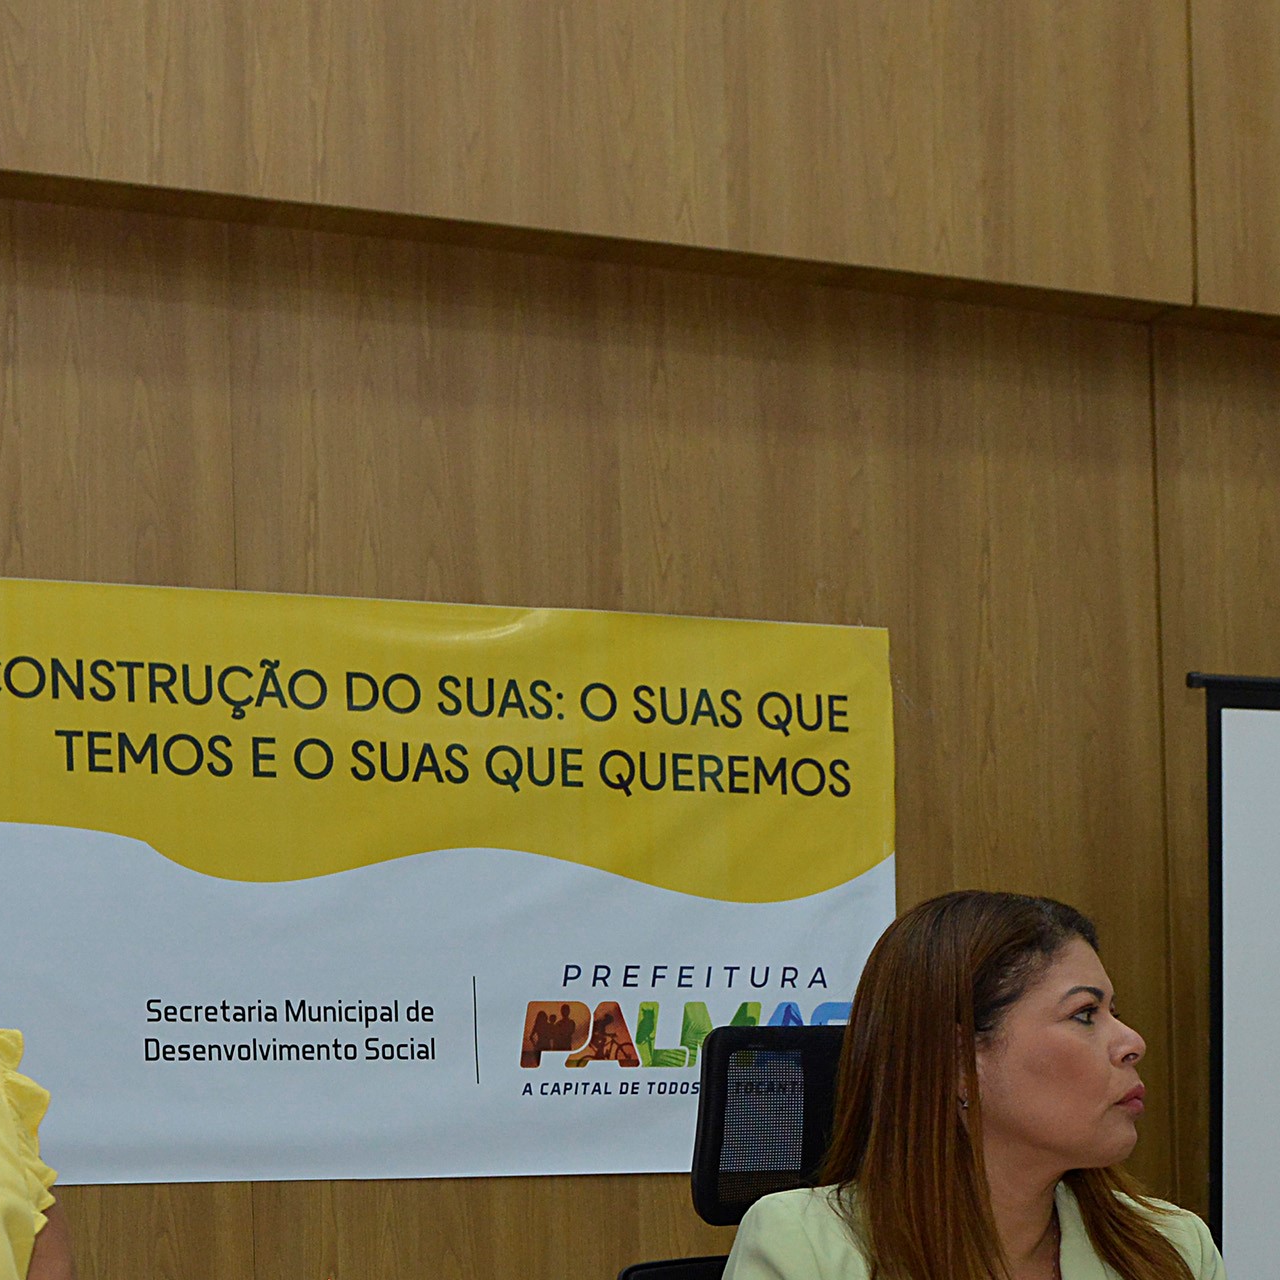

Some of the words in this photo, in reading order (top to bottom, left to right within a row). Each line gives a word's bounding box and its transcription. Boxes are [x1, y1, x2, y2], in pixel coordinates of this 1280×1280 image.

[346, 671, 422, 715] DO
[436, 674, 565, 721] SUAS:
[580, 682, 617, 723] O
[632, 684, 744, 729] SUAS
[756, 690, 850, 737] QUE
[54, 729, 234, 778] TEMOS
[251, 736, 278, 778] E
[293, 737, 335, 781] O
[349, 739, 470, 784] SUAS
[484, 744, 584, 793] QUE
[598, 748, 852, 799] QUEREMOS
[562, 964, 829, 989] PREFEITURA
[146, 999, 278, 1022] Secretaria
[285, 999, 399, 1028] Municipal
[406, 1000, 434, 1022] de
[144, 1038, 357, 1061] Desenvolvimento
[364, 1037, 436, 1060] Social
[522, 1082, 534, 1096] A
[539, 1081, 612, 1096] CAPITAL
[619, 1081, 640, 1095] DE
[647, 1081, 701, 1095] TODOS
